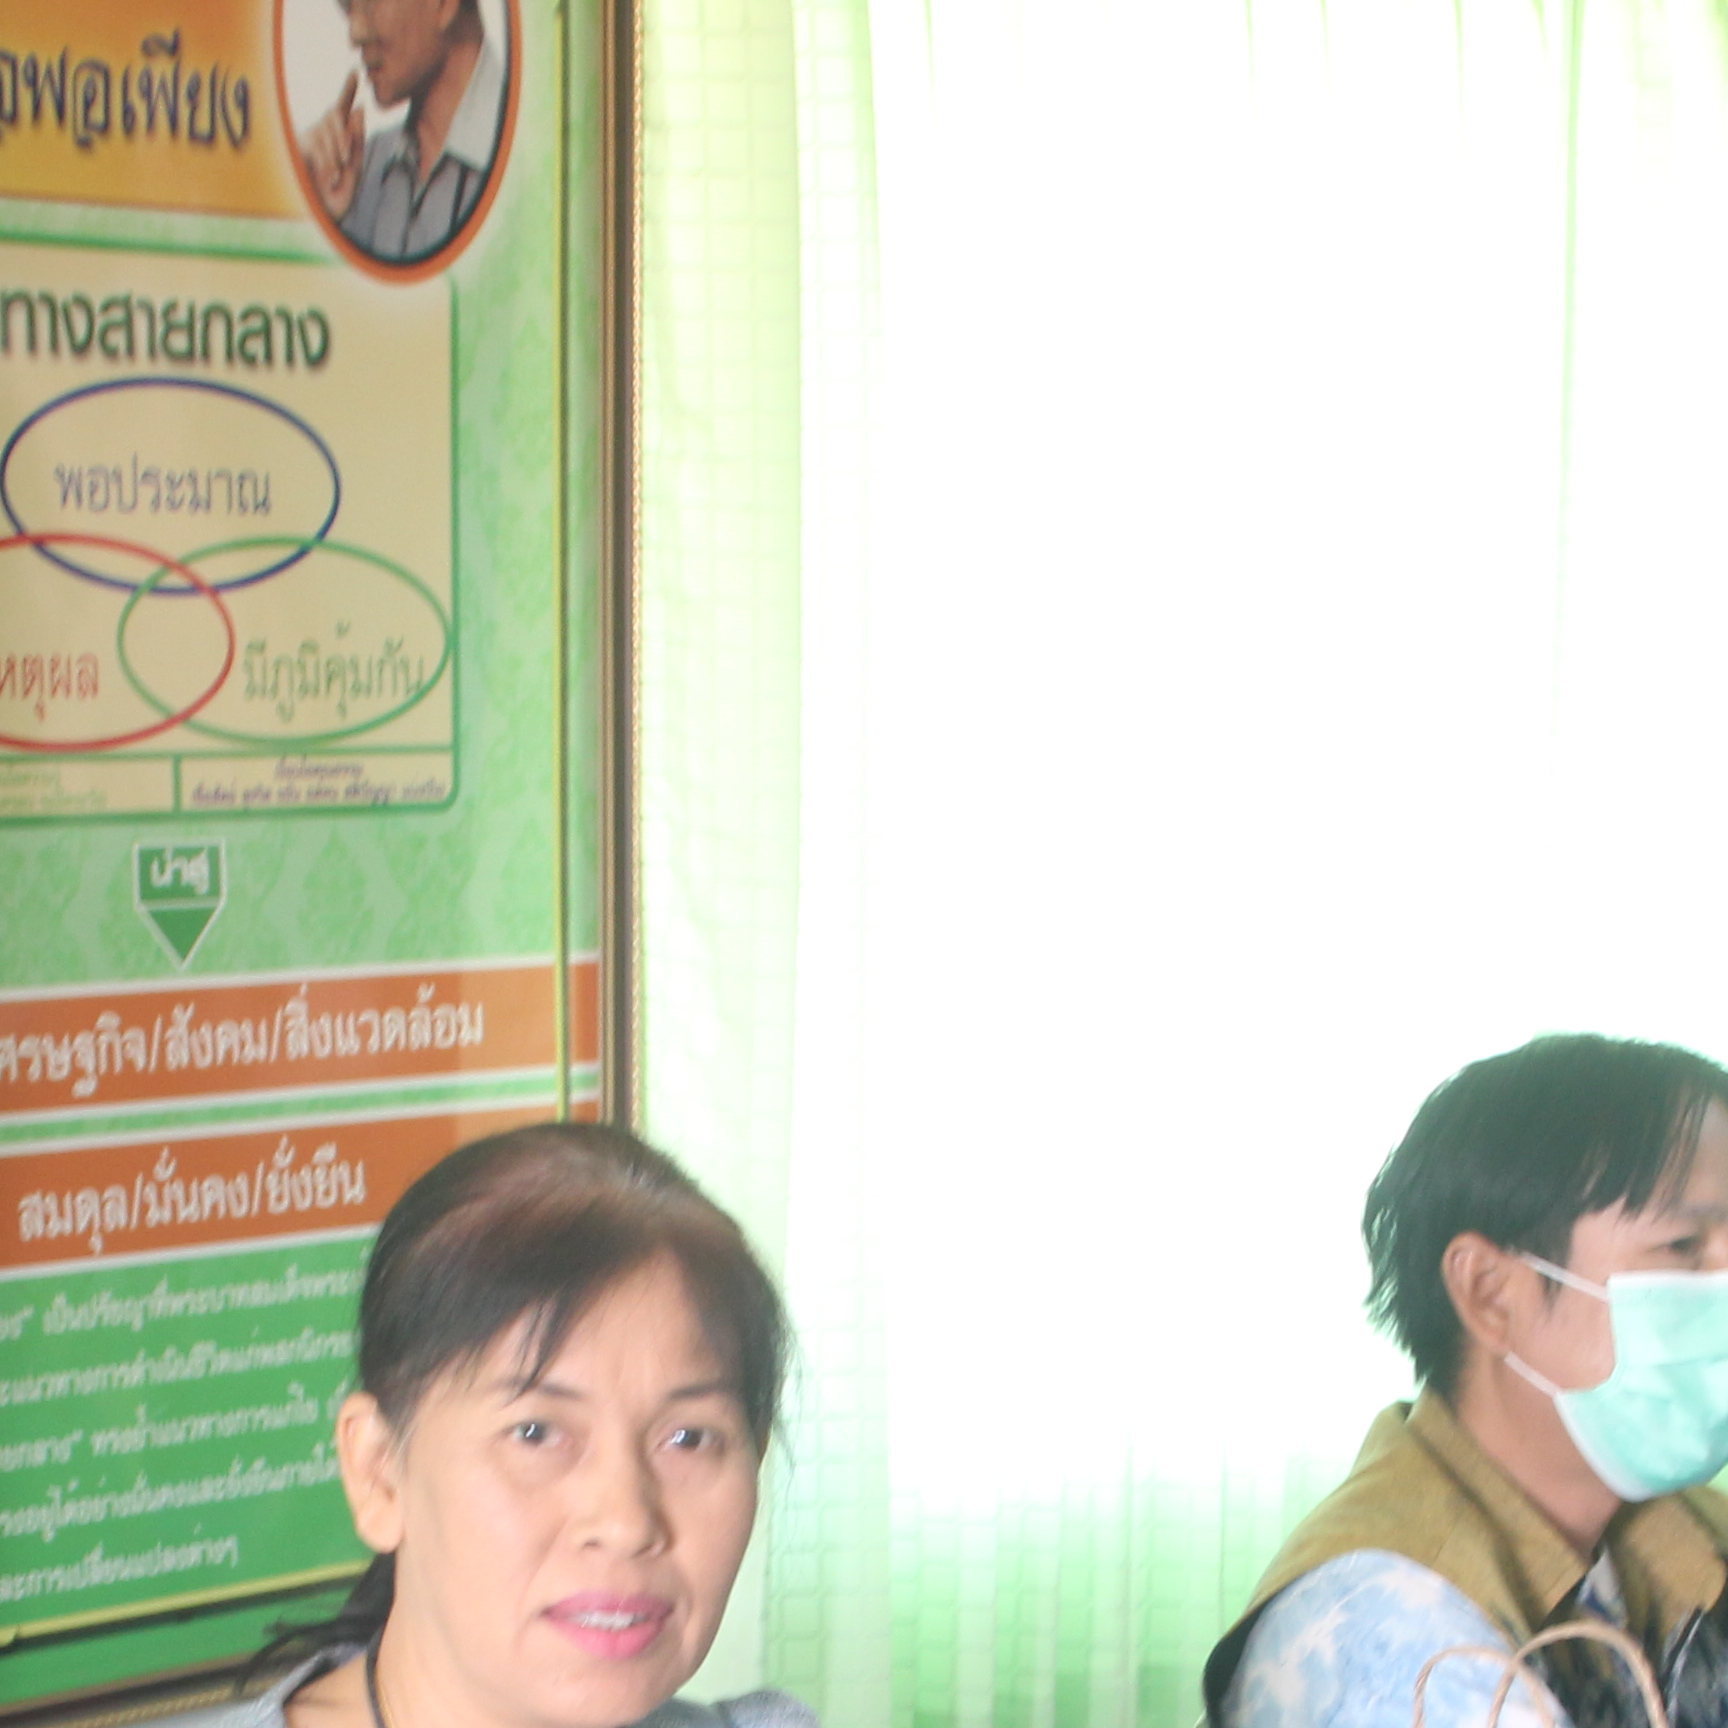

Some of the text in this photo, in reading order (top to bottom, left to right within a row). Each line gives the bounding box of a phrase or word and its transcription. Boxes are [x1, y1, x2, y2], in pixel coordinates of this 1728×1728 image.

[52, 453, 273, 519] พอประมาณ
[241, 619, 429, 722] มีภูมิคุ้มกัน
[16, 1132, 367, 1256] สมดุล/มั่นคง/ยั่งยืน
